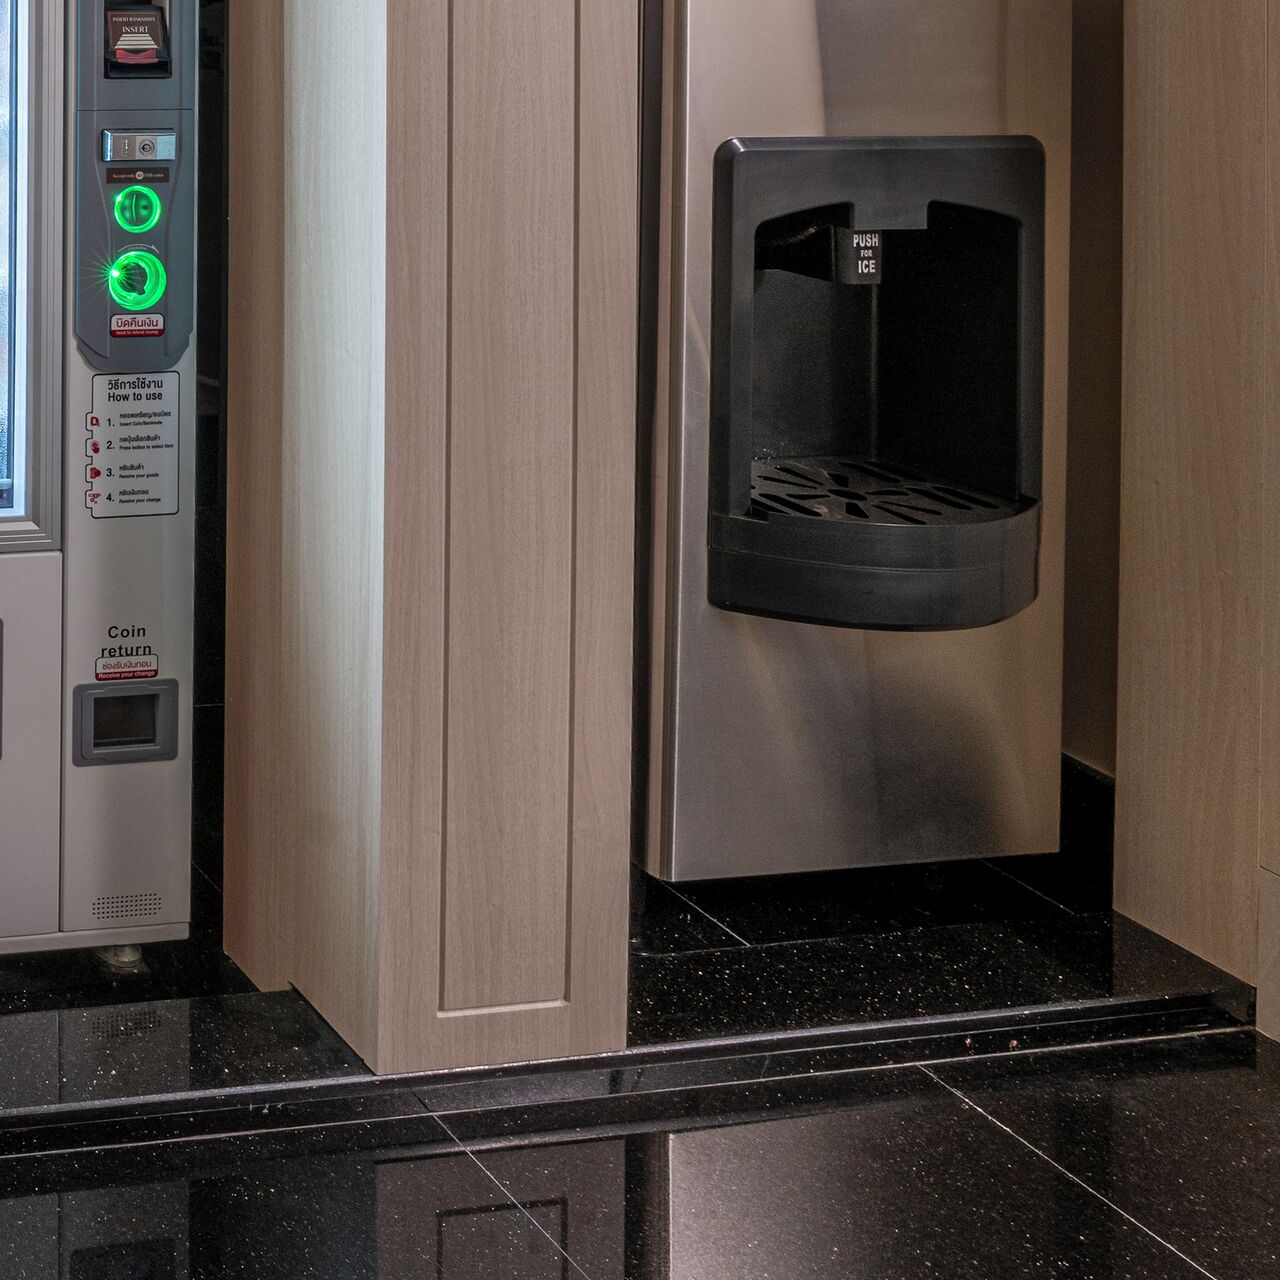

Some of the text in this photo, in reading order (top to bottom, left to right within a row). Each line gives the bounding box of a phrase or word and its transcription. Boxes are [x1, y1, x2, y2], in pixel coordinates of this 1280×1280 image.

[853, 233, 879, 247] PUSH
[860, 249, 873, 257] FOR
[858, 260, 876, 273] ICE
[116, 317, 159, 328] บิดคืนเงิน
[107, 377, 163, 391] วิธีการใช้งาน
[108, 392, 163, 402] How to use
[106, 417, 115, 427] 1.
[106, 440, 115, 450] 2.
[106, 467, 115, 477] 3.
[106, 492, 115, 502] 4.
[108, 625, 146, 639] Coin
[101, 644, 152, 658] return
